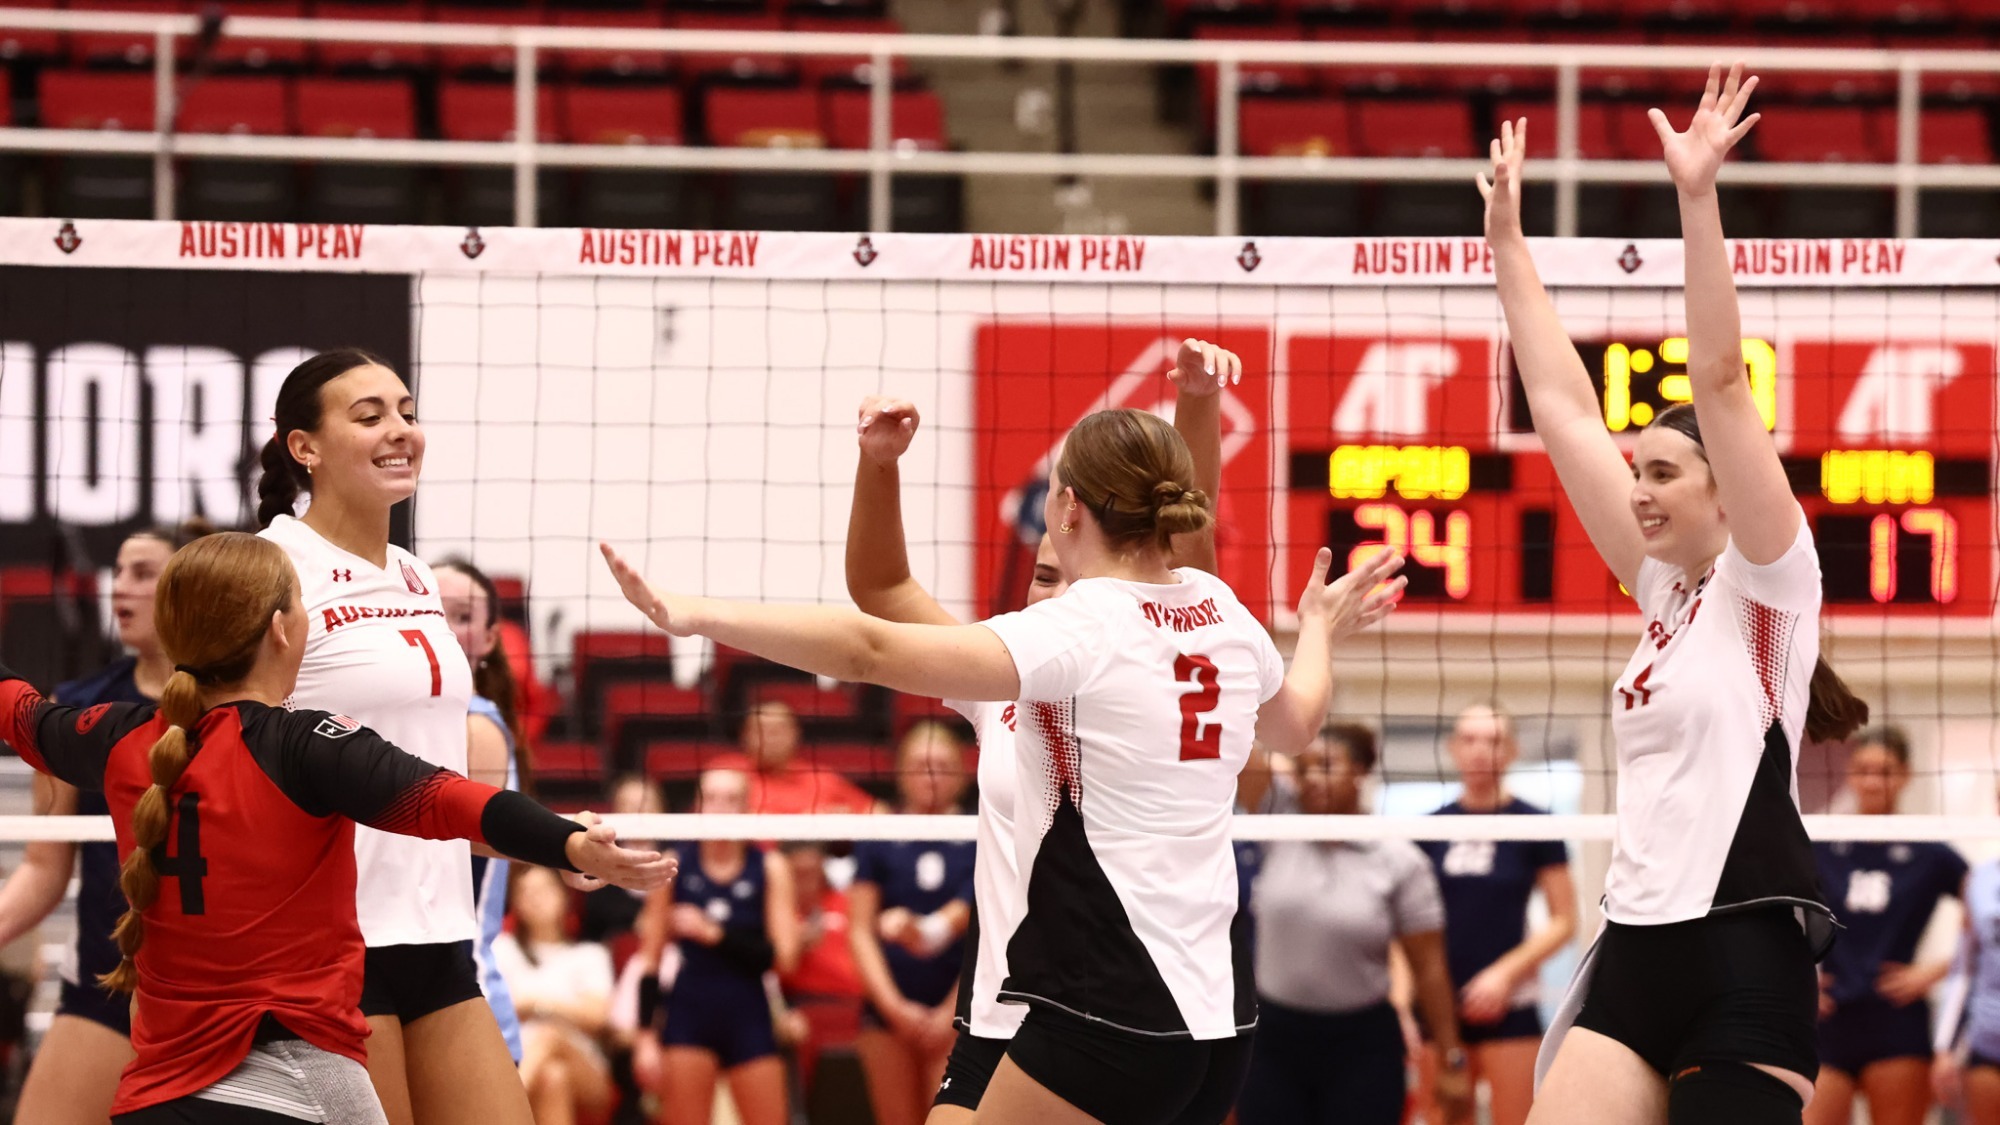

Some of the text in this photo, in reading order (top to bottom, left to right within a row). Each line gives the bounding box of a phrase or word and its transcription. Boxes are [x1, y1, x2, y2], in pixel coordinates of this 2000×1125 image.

[180, 221, 364, 259] AUSTIN PEAY
[580, 229, 759, 267] AUSTIN PEAY
[970, 235, 1145, 271] AUSTIN PEAY
[1352, 241, 1494, 274] AUSTIN PE
[1733, 239, 1906, 275] AUSTIN PEAY
[1348, 503, 1471, 600] 24
[1870, 508, 1957, 604] 17
[398, 629, 442, 698] 7
[1173, 651, 1223, 761] 2
[156, 790, 208, 916] 4
